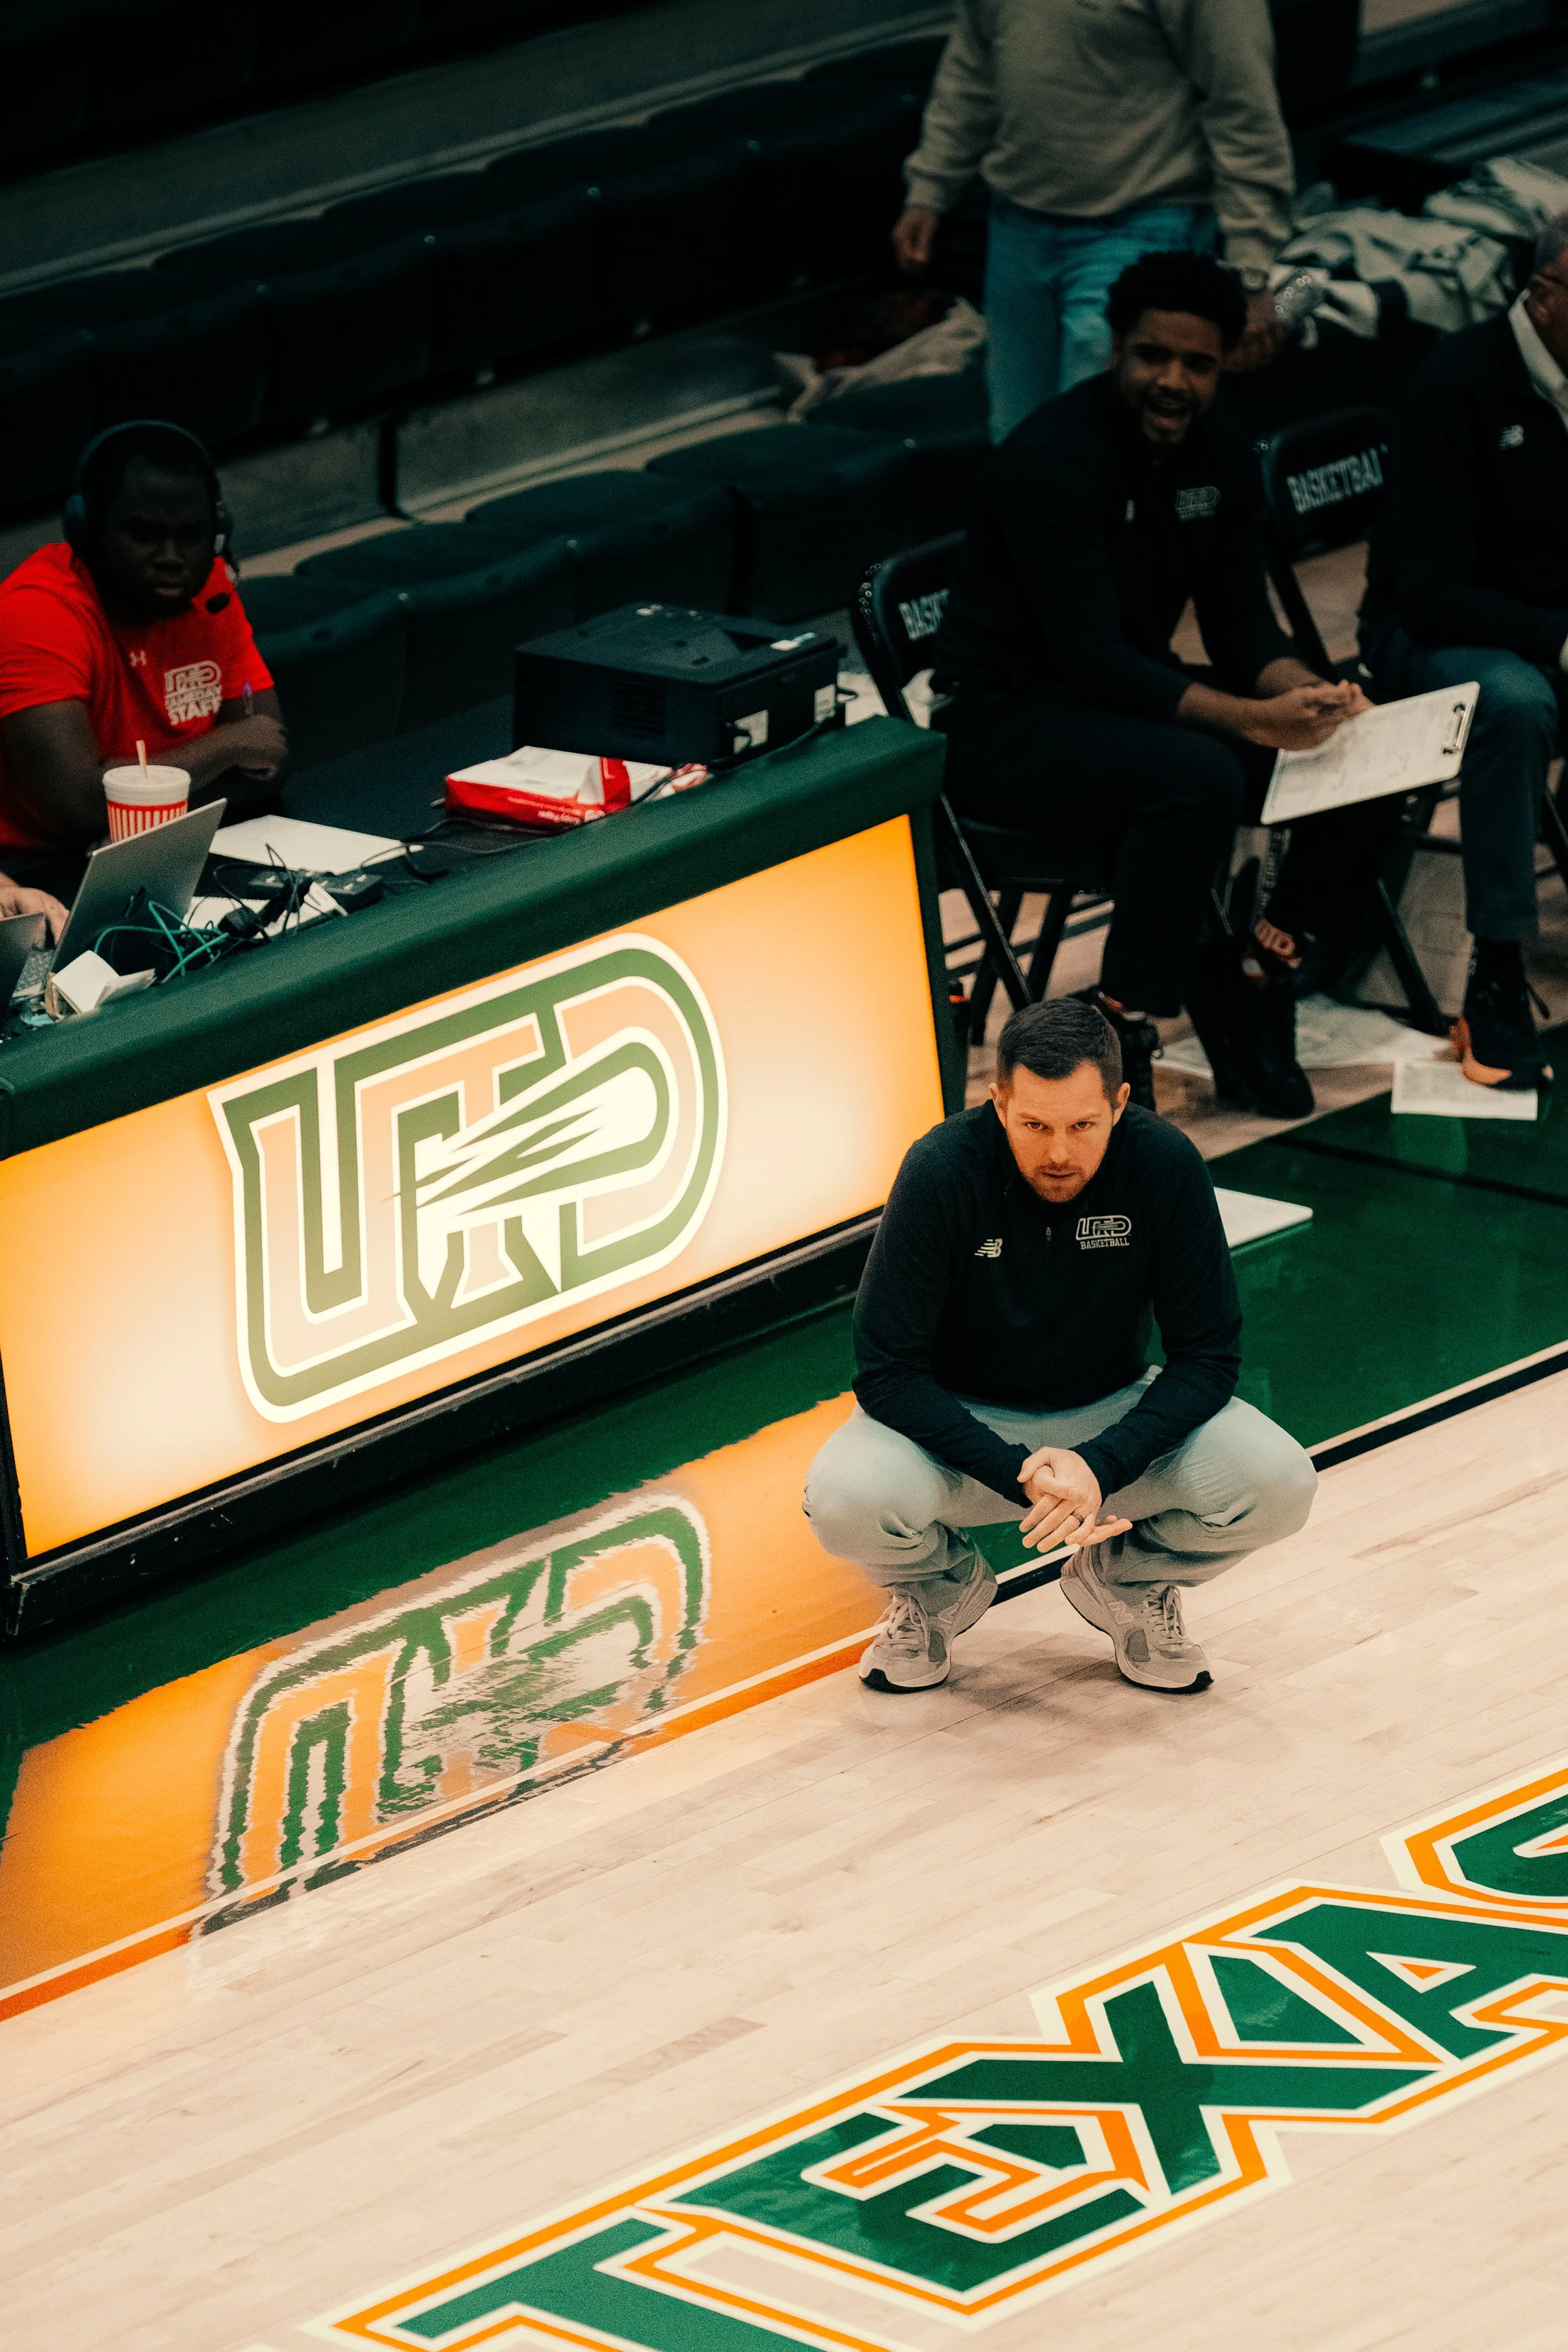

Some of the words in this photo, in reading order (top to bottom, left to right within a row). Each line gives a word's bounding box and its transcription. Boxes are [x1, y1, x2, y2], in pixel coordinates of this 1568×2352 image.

[1286, 443, 1389, 516] BASKETBAL
[207, 932, 728, 1423] UTD
[1075, 1214, 1132, 1241] UTD
[1079, 1237, 1130, 1251] BASKETBALL
